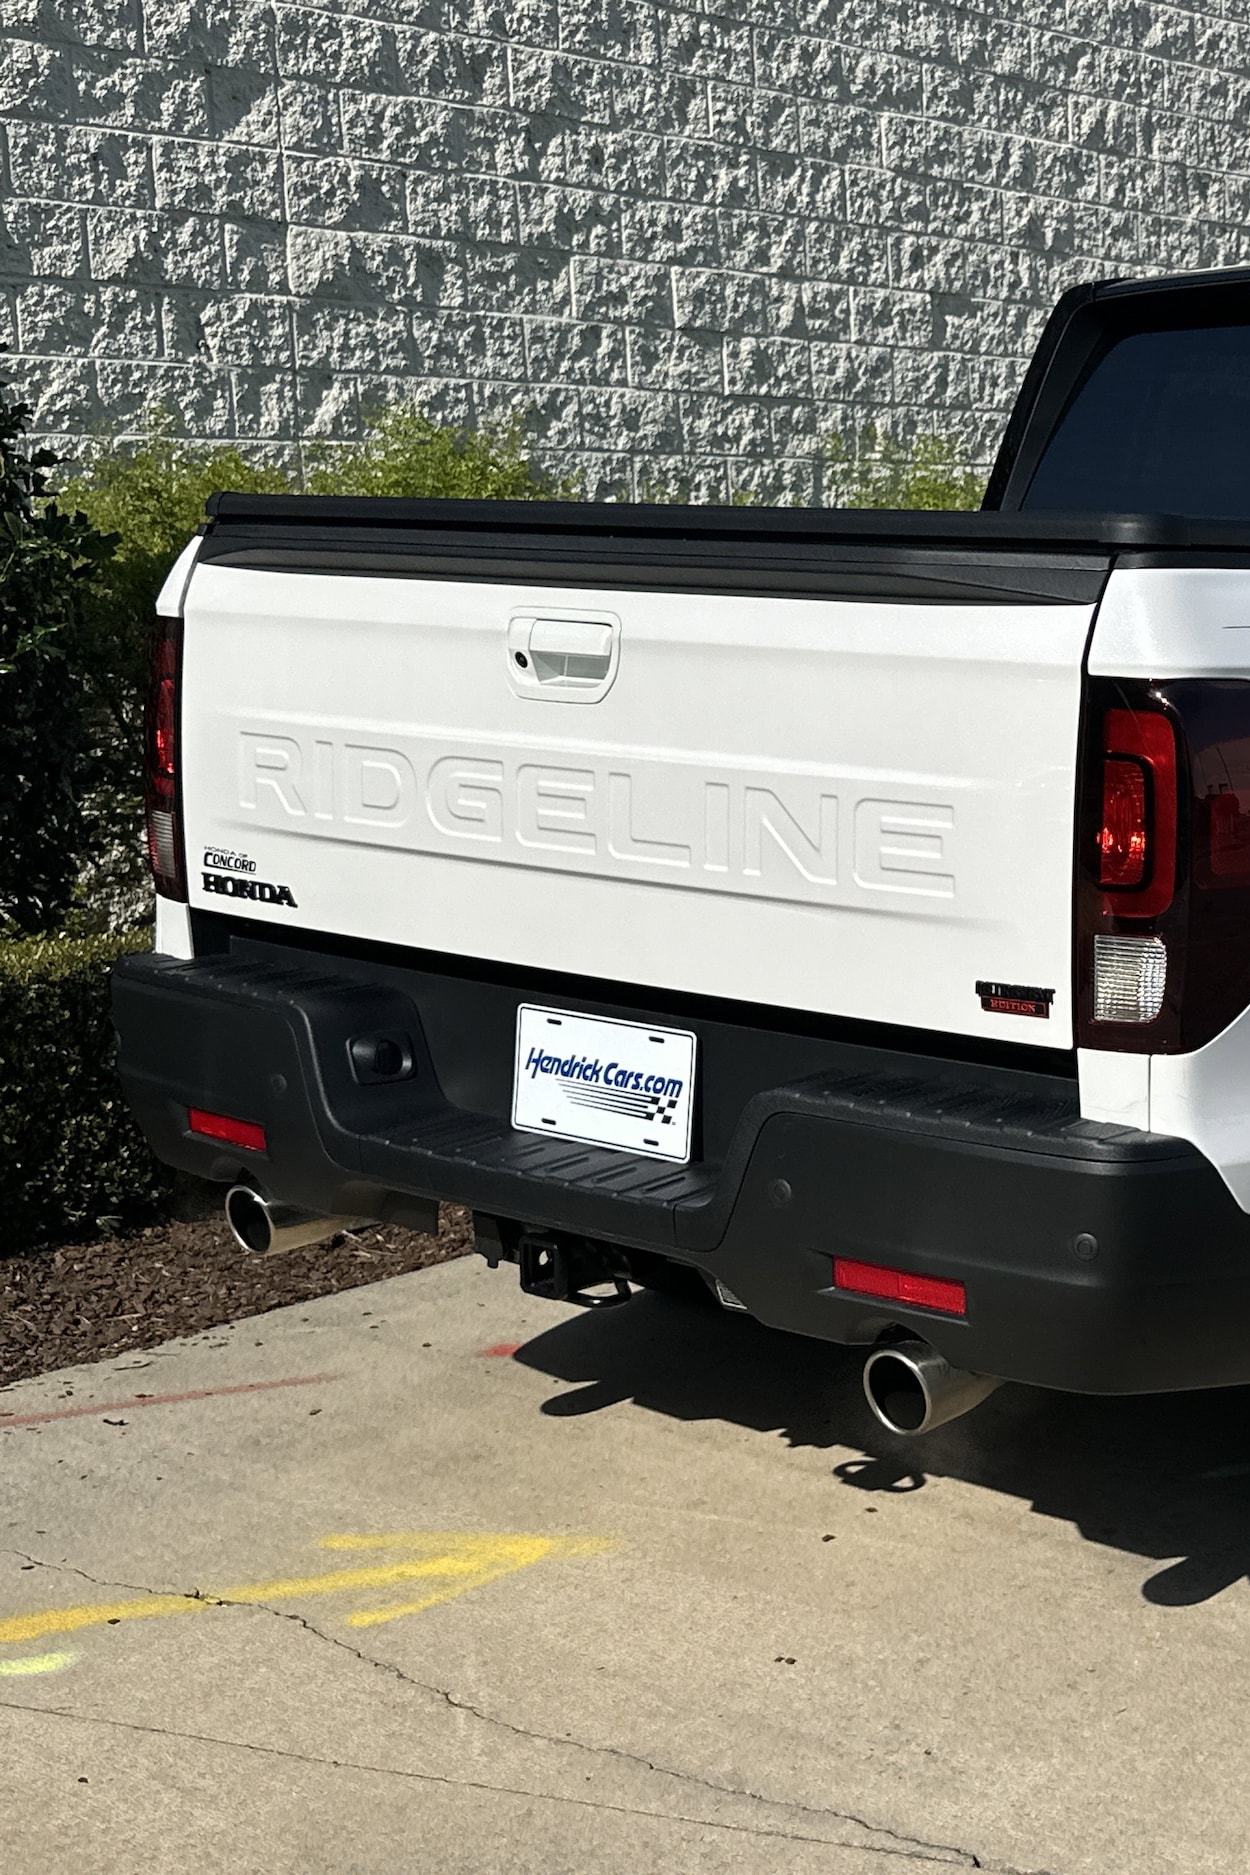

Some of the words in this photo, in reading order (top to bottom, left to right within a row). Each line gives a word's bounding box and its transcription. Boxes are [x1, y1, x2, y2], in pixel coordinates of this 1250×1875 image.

[240, 731, 955, 898] RIDGELINE
[204, 851, 257, 874] CONCORD
[201, 872, 298, 908] HONDA
[990, 999, 1036, 1012] EDITION
